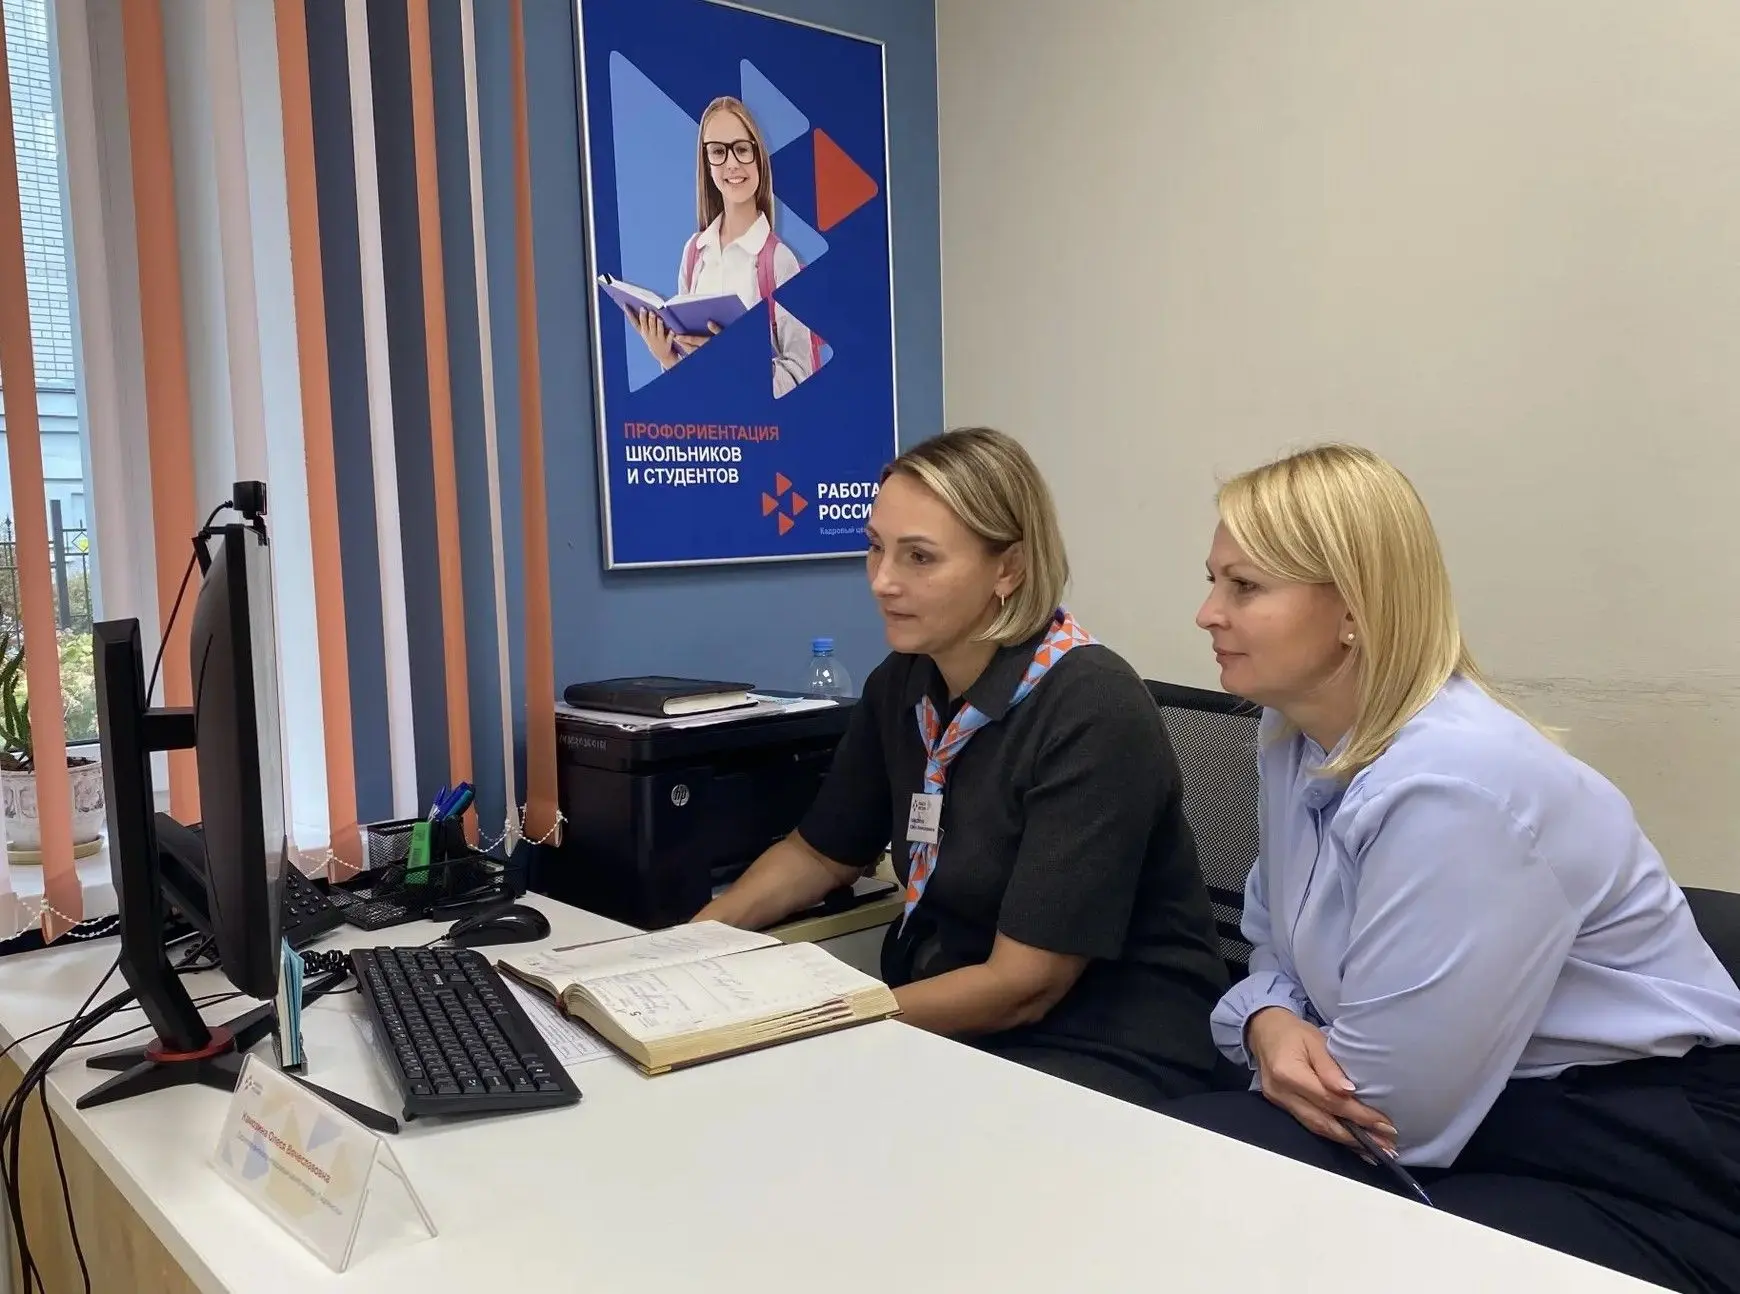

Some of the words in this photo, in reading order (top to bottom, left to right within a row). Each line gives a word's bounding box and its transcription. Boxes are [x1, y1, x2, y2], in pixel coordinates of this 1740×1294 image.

[624, 422, 780, 442] ПРОФОРИЕНТАЦИЯ
[625, 445, 742, 462] ШКОЛЬНИКОВ
[627, 468, 639, 484] И
[644, 468, 739, 486] СТУДЕНТОВ
[817, 482, 880, 499] РАБОТА
[818, 503, 872, 521] РОССИ
[671, 784, 690, 807] hp
